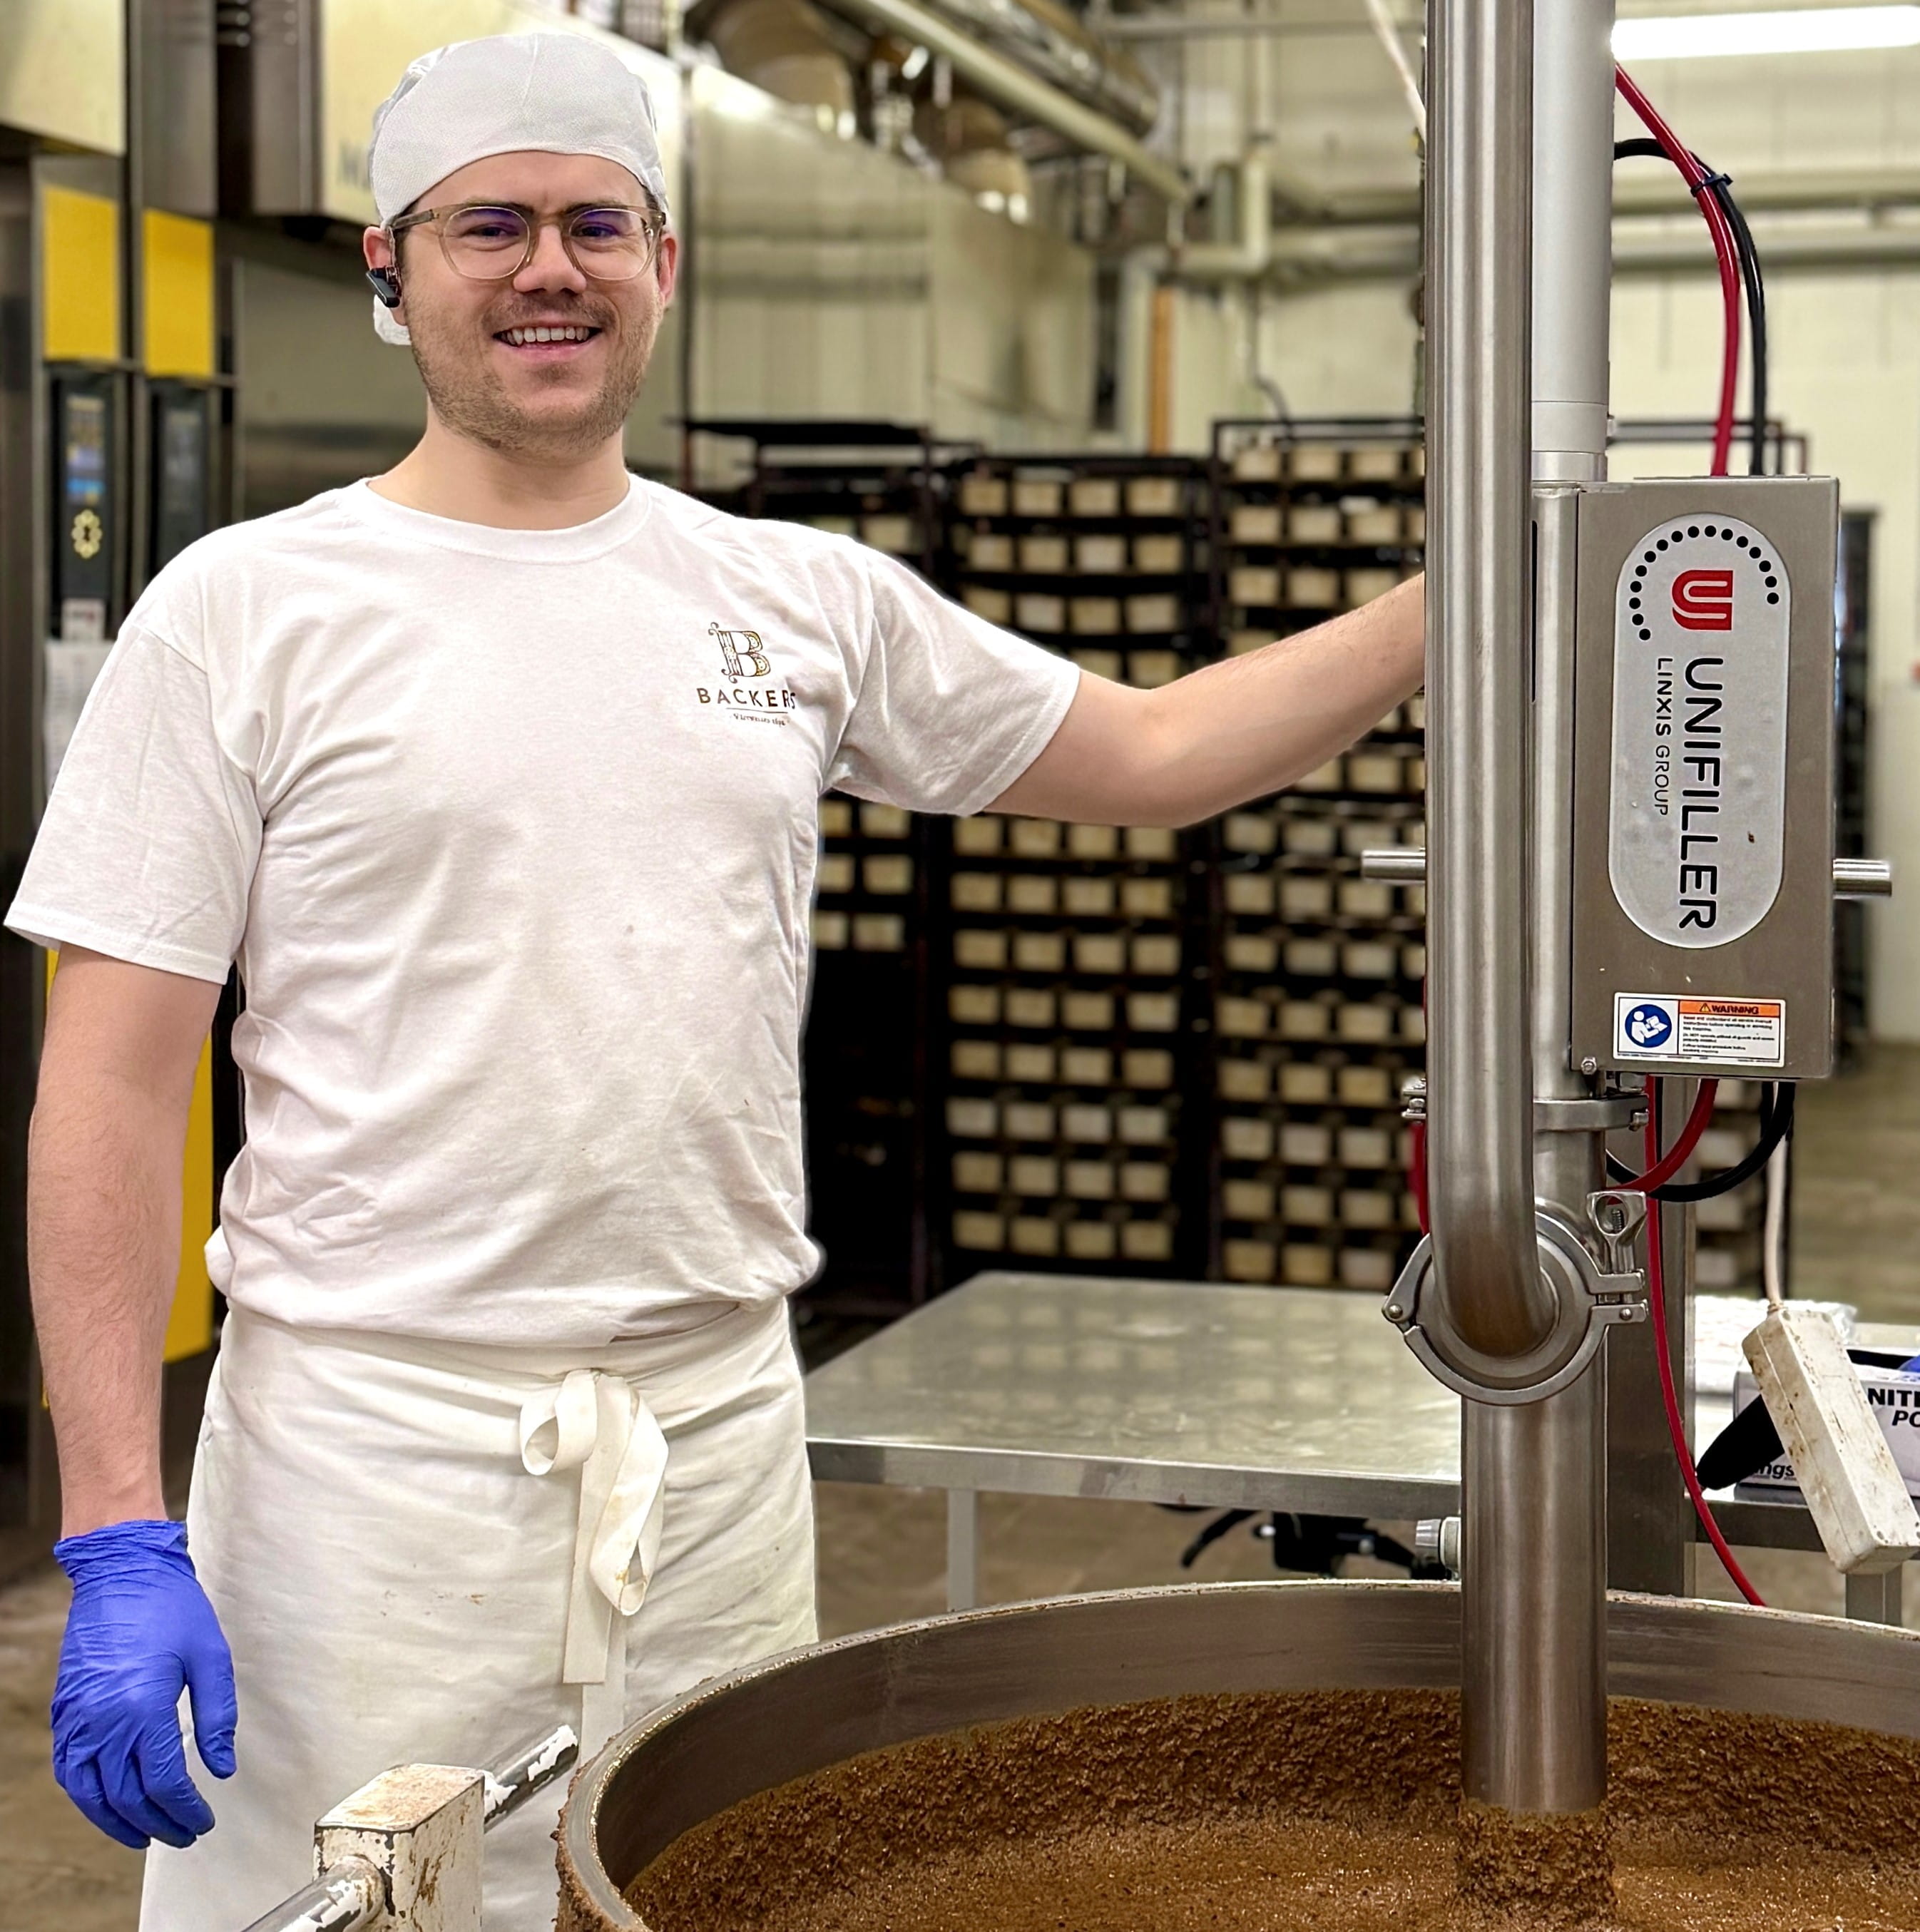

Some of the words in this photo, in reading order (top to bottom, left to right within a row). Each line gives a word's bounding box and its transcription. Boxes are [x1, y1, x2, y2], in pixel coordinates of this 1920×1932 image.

[696, 688, 796, 710] BACKERS
[1655, 658, 1673, 737] LINXIS
[1654, 745, 1670, 816] GROUP
[1679, 658, 1724, 929] UNIFILLER
[1712, 1005, 1759, 1014] WARNING
